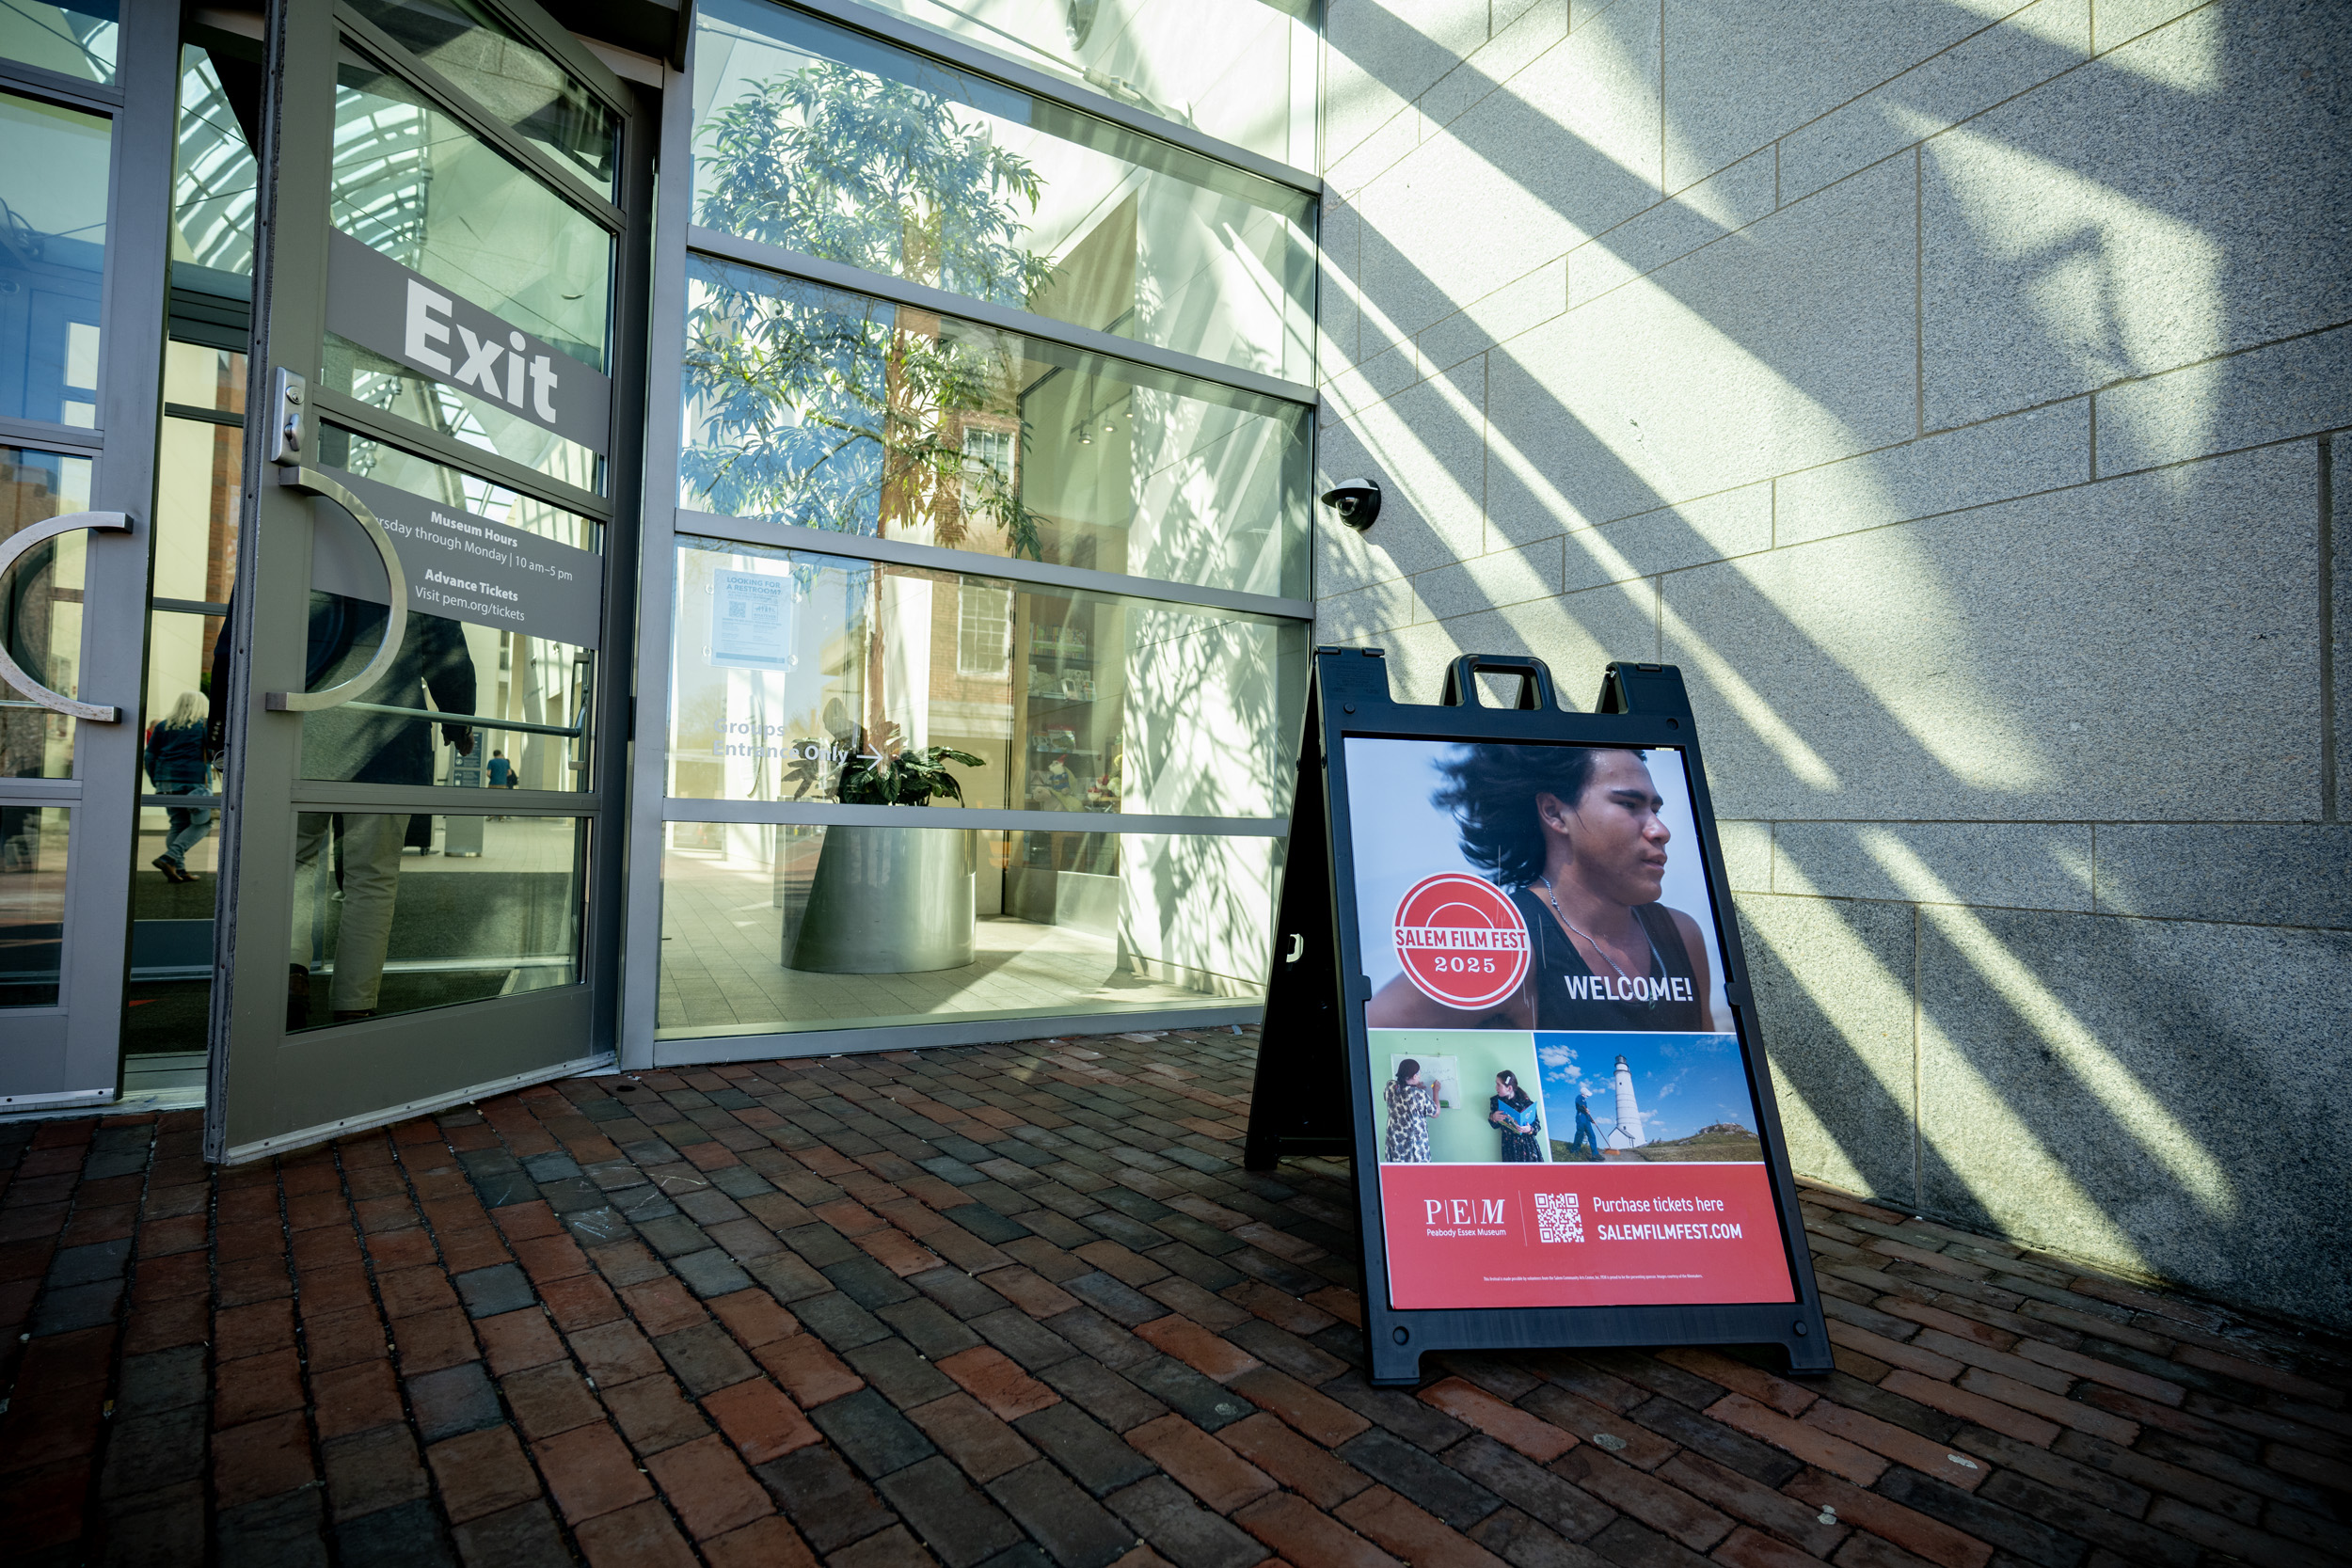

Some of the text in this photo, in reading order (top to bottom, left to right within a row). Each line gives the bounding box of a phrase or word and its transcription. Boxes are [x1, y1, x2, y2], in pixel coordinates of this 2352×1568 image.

[405, 277, 558, 424] Exit
[431, 511, 518, 547] Museum Hours
[375, 517, 413, 539] rsday
[415, 527, 462, 550] through
[465, 540, 507, 564] Monday
[516, 555, 527, 568] 10
[557, 569, 573, 581] pm
[425, 569, 518, 602] Advance Tickets
[727, 577, 763, 586] LOOKING
[734, 584, 782, 595] RESTROOM?
[415, 585, 525, 622] Visit pem.org/tickets
[714, 718, 785, 739] Groups
[713, 739, 849, 766] Entrance Only
[1395, 928, 1526, 949] SALEM FILM FEST
[1434, 956, 1496, 974] 2025
[1564, 974, 1693, 1002] WELCOME!
[1593, 1196, 1724, 1212] Purchase tickets here
[1426, 1227, 1456, 1238] Peabody
[1597, 1223, 1743, 1241] SALEMFILMFEST.COM
